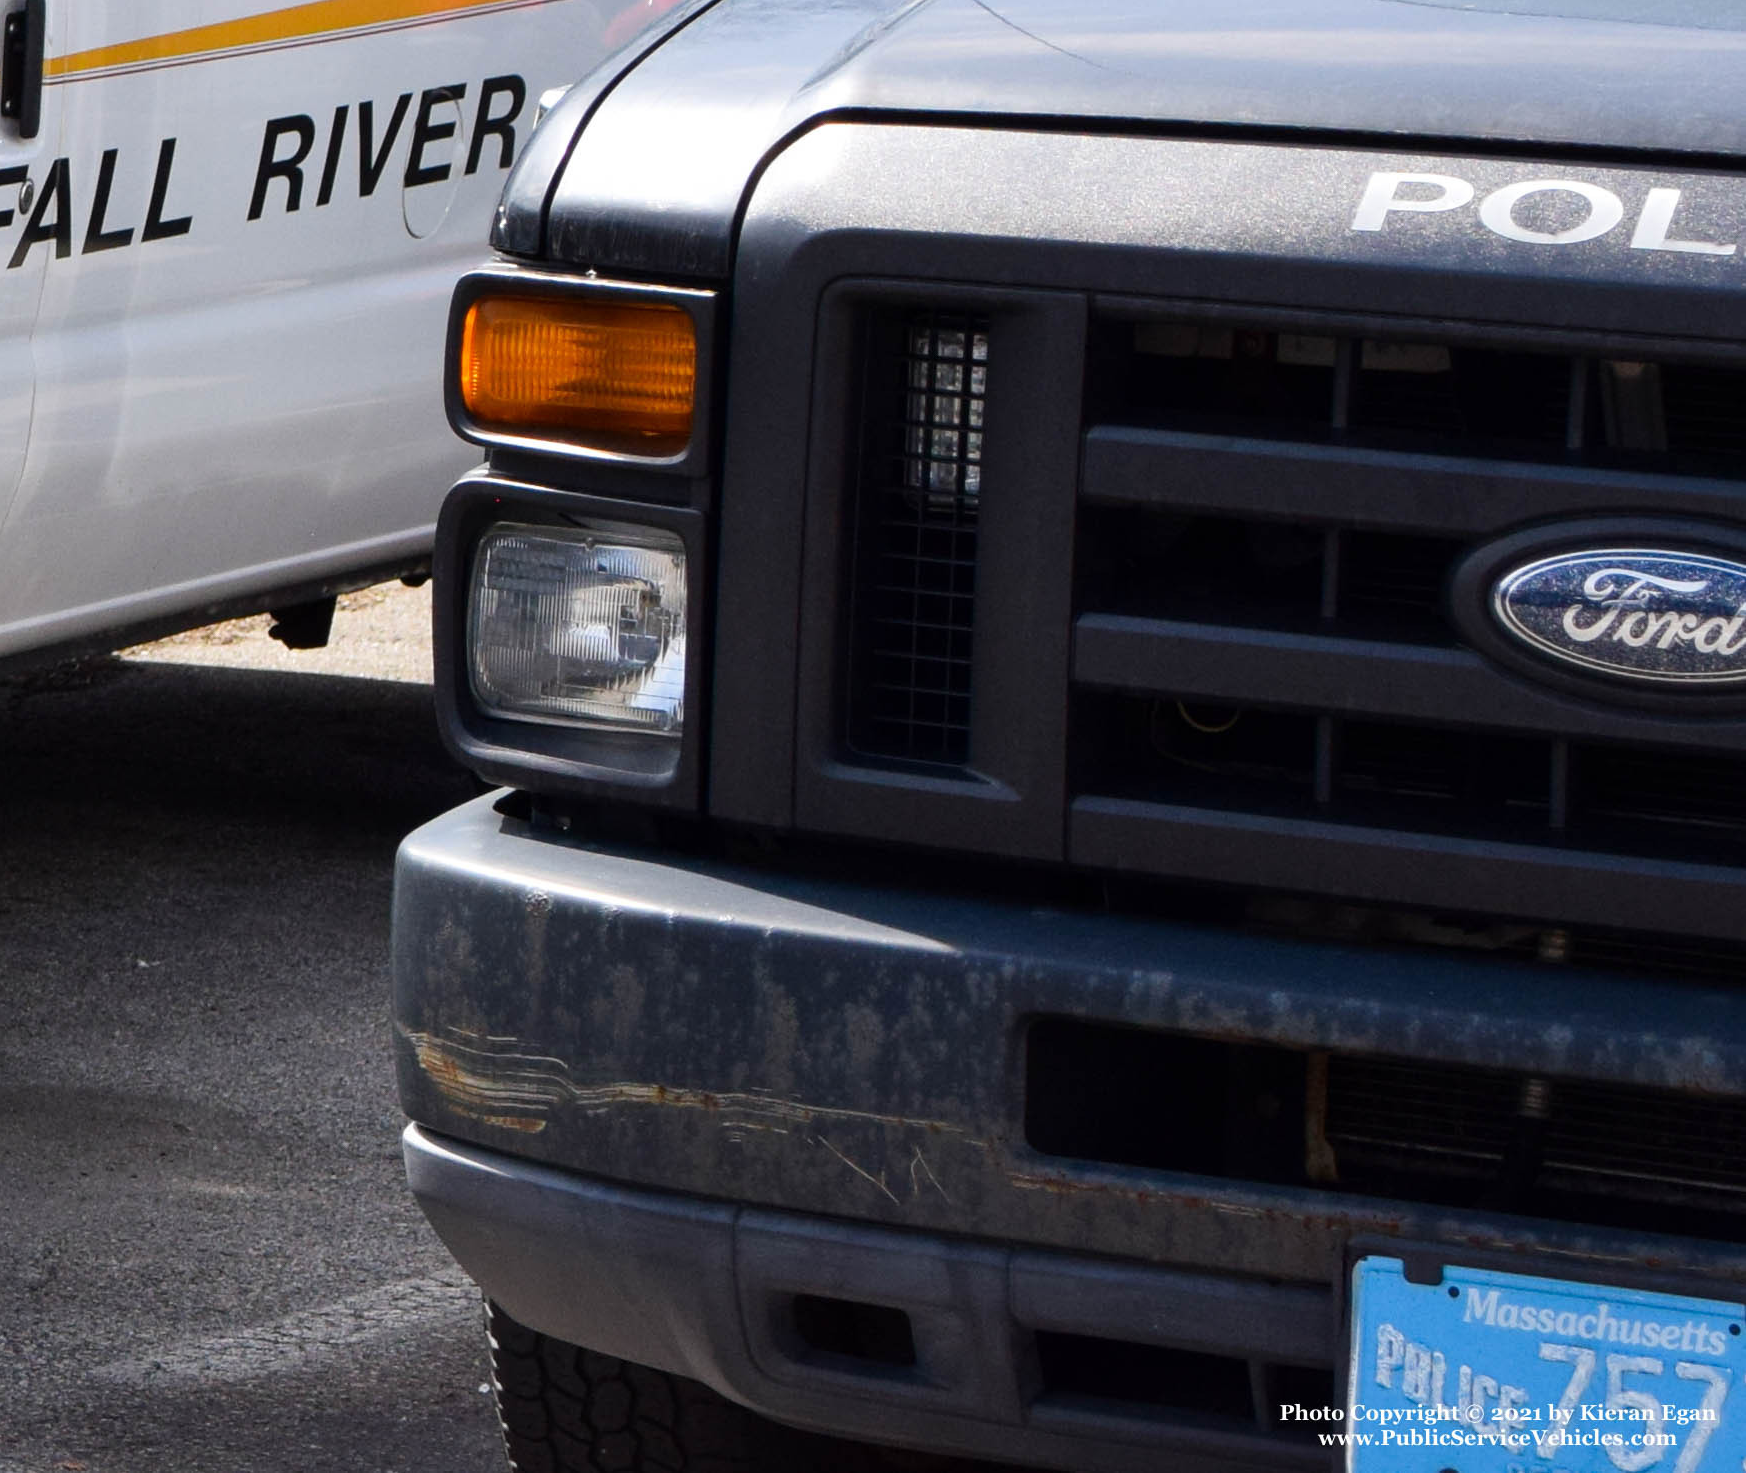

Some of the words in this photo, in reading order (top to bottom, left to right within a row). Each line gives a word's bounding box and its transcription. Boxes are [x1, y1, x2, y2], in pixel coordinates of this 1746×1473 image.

[247, 74, 527, 221] RIVER
[1463, 1288, 1726, 1356] Massachusetts
[1538, 1342, 1746, 1473] 757
